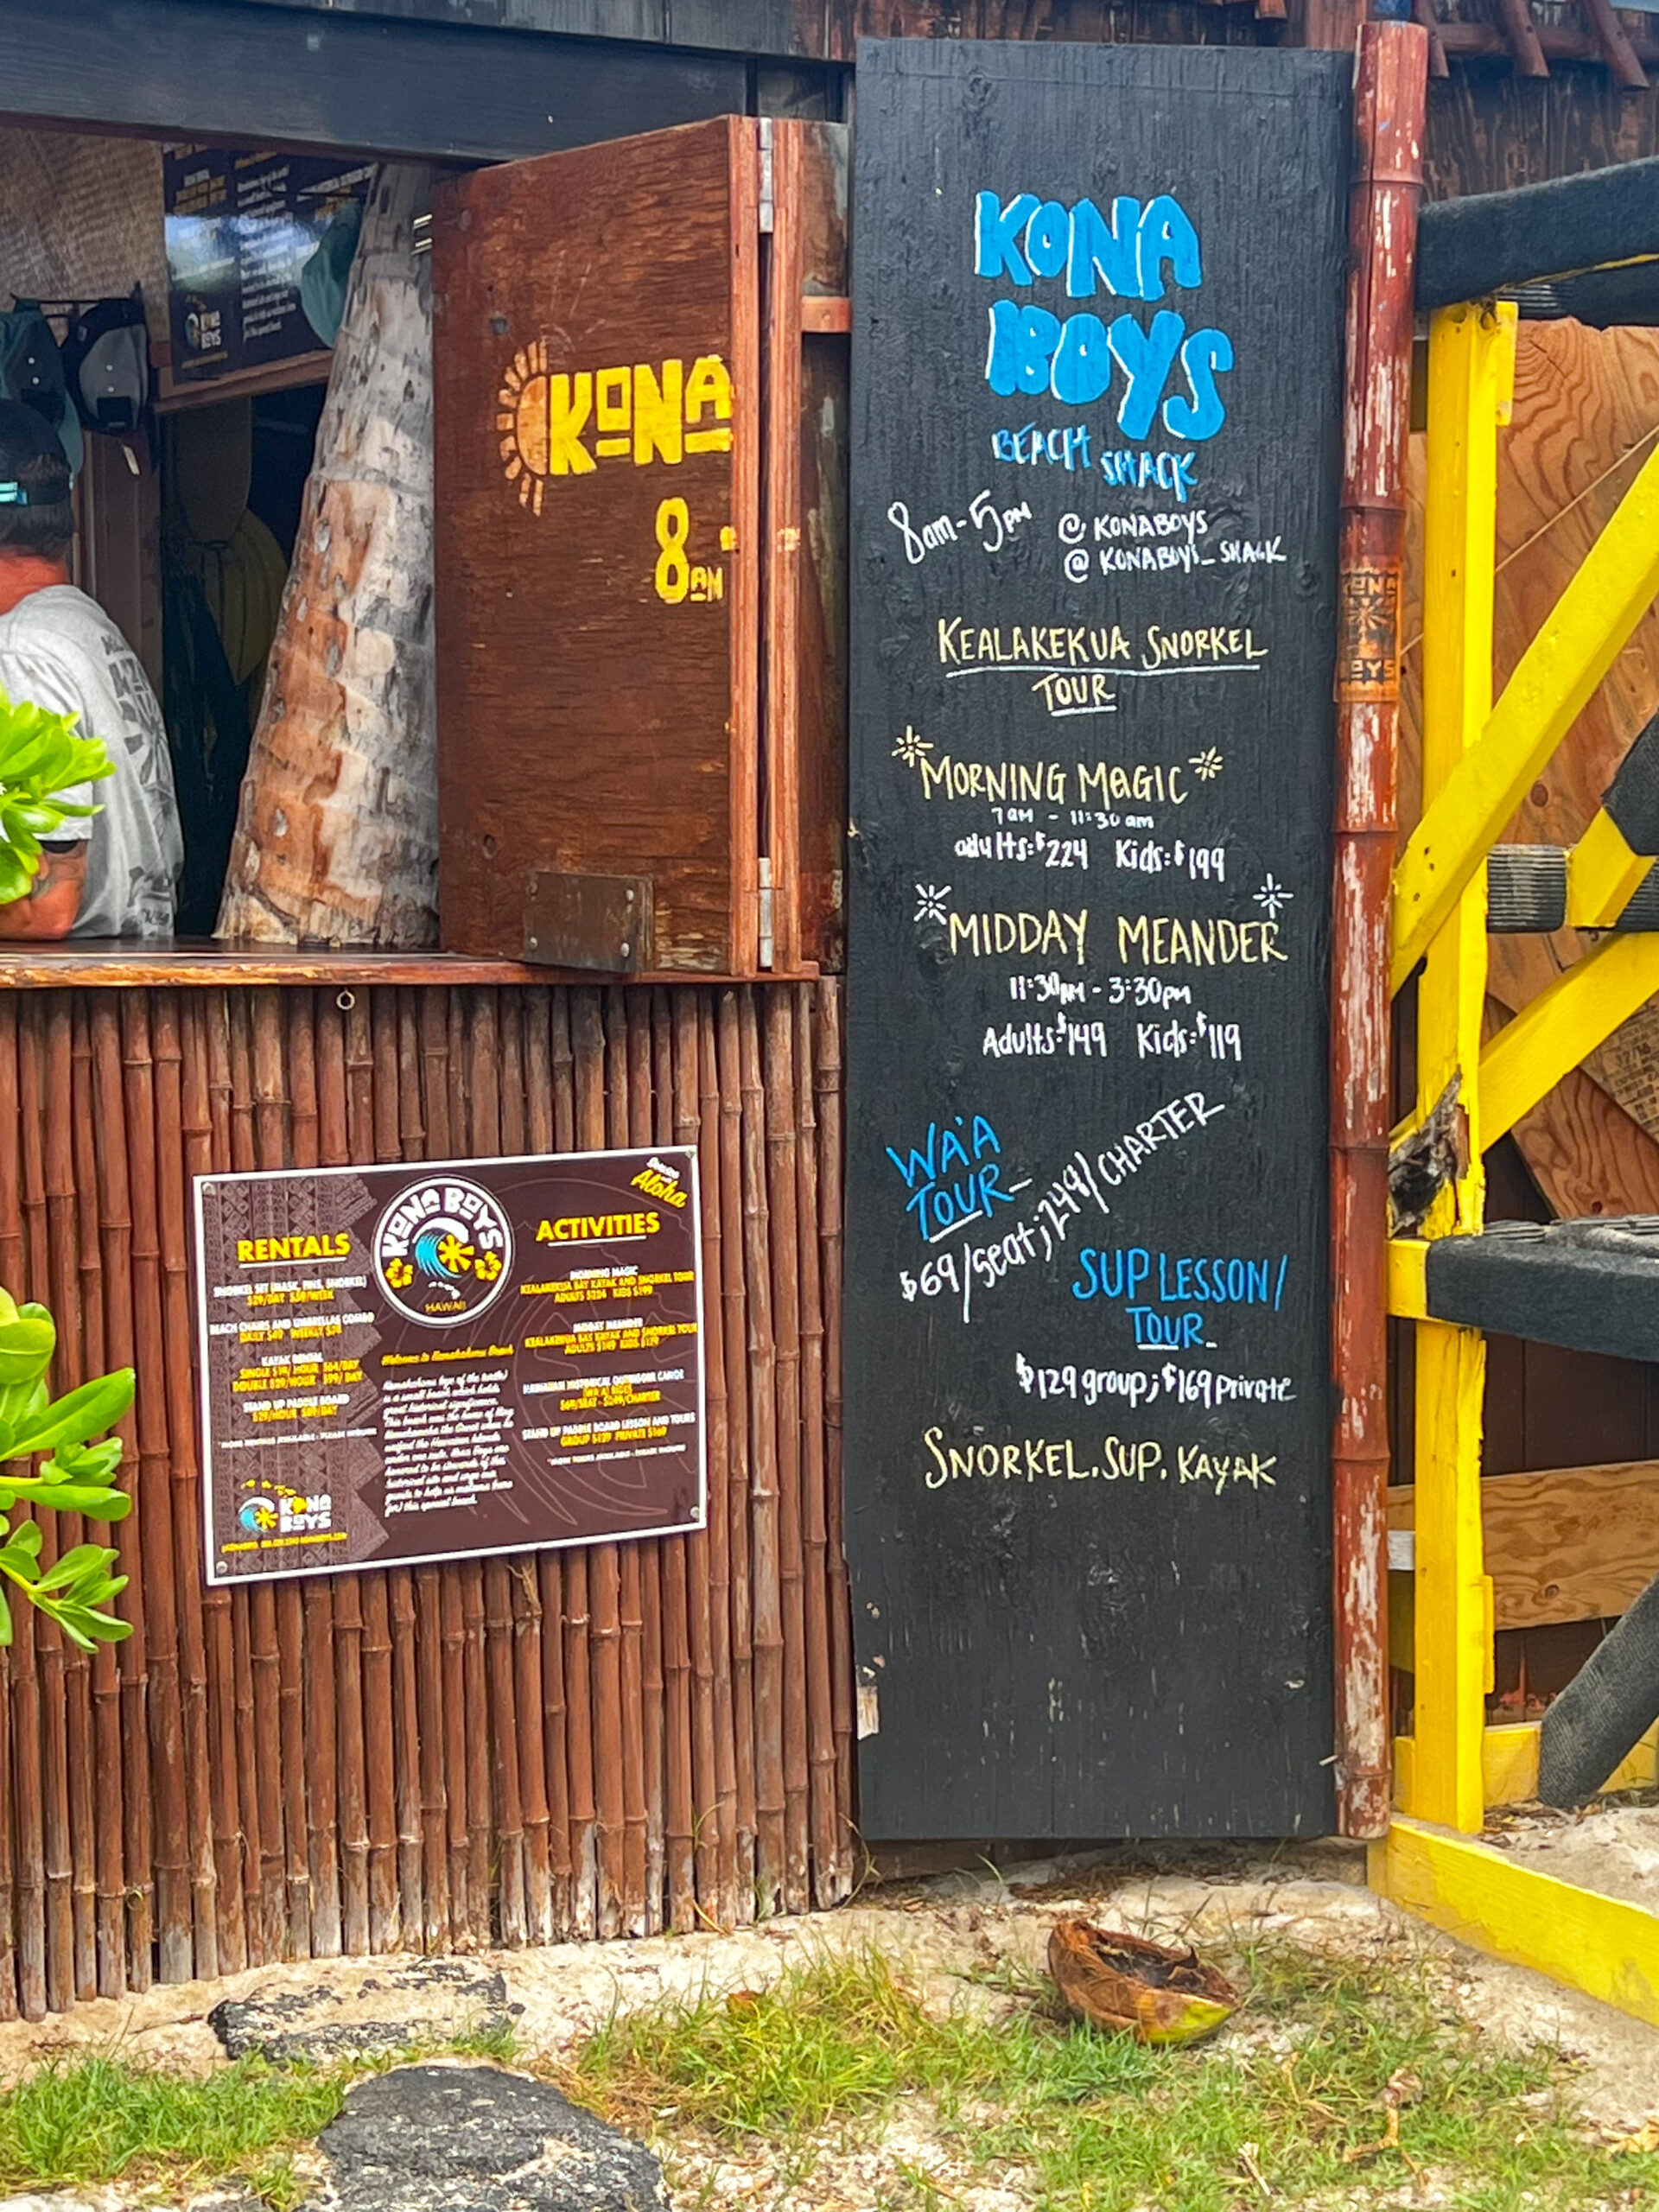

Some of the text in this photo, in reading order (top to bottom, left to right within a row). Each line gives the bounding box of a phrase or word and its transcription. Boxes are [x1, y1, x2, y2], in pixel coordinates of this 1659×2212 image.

[975, 189, 1202, 301] KONA
[985, 299, 1234, 441] BOYS
[550, 355, 735, 475] KONA
[991, 422, 1091, 471] BEACH
[1100, 450, 1198, 504] SHACK
[938, 616, 1268, 670] KEALAKEKUA SNORKEL
[1033, 672, 1116, 710] TOUR
[920, 755, 1067, 801] MORNING
[950, 910, 1288, 966] MIDDAY MEANDER
[631, 1169, 688, 1208] Aloha
[907, 1163, 1014, 1242] TOUR
[238, 1233, 351, 1262] RENTALS
[382, 1187, 504, 1257] KONA BOYS
[536, 1211, 660, 1242] ACTIVITIES
[1072, 1248, 1149, 1300] SUP
[1125, 1306, 1204, 1350] TOUR
[1016, 1352, 1077, 1400] $129
[1178, 1445, 1277, 1496] KAYAK
[280, 1511, 332, 1533] BOYS
